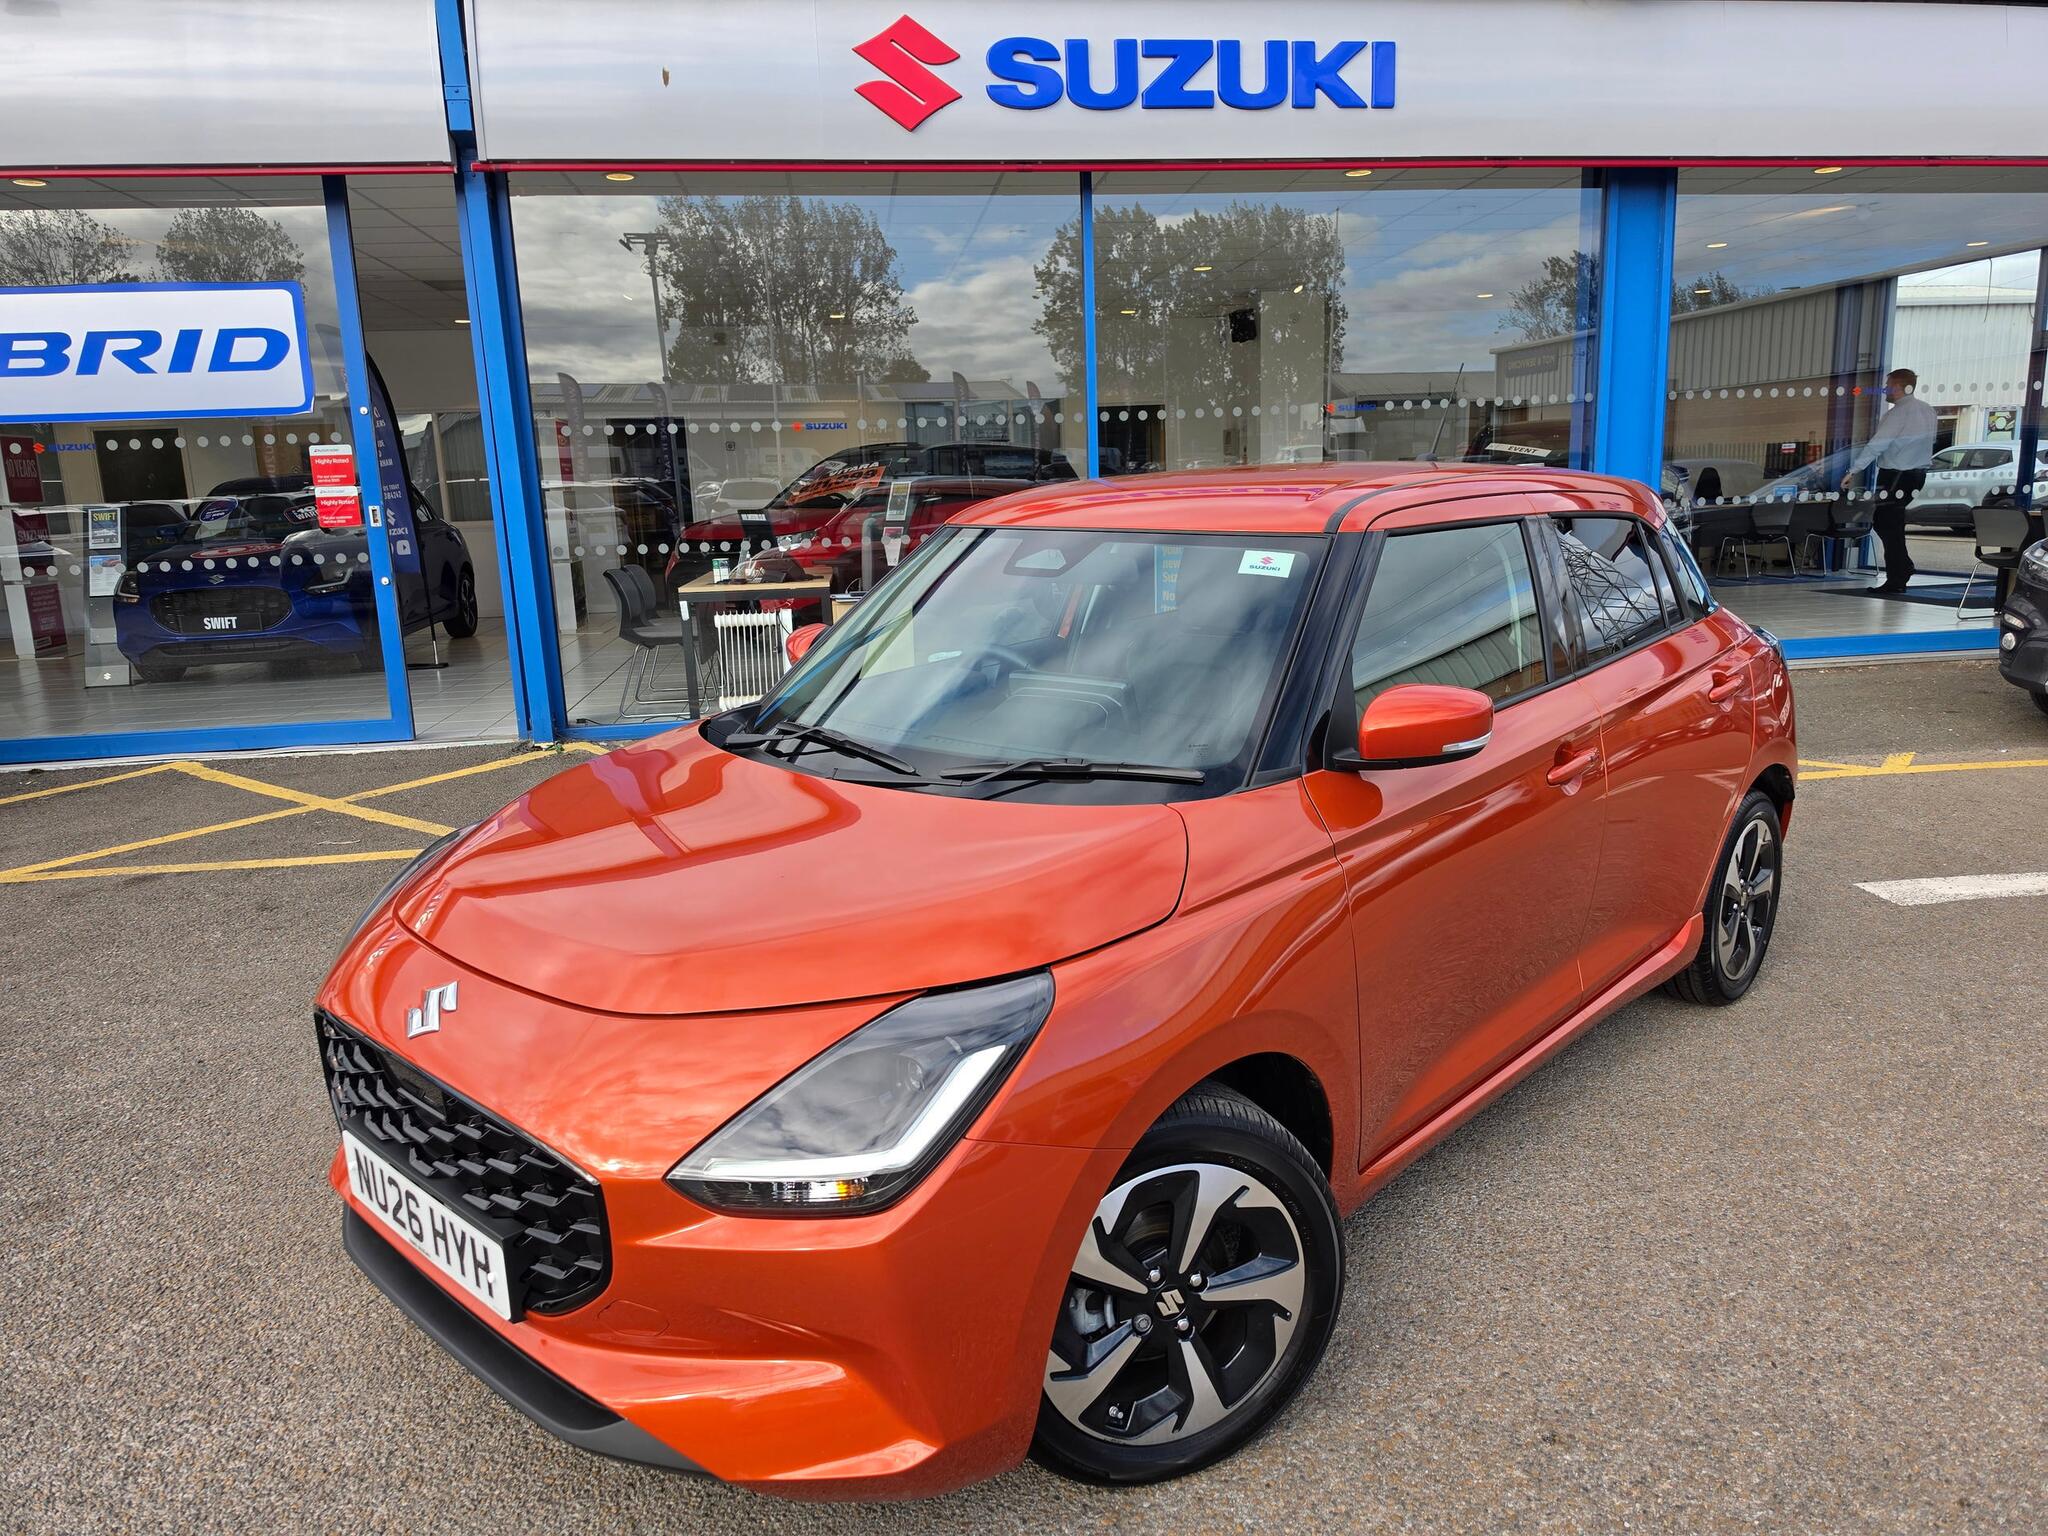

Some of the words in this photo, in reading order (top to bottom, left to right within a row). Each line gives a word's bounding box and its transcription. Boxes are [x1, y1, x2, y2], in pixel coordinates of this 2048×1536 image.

[985, 36, 1397, 110] SUZUKI
[0, 327, 291, 378] BRID
[805, 422, 848, 431] SUZUKI
[1507, 446, 1537, 454] EVENT
[15, 459, 38, 478] YEARS
[829, 461, 879, 476] VITARA
[93, 512, 116, 521] SWIFT
[1249, 564, 1281, 572] SUZUKI
[203, 616, 237, 630] SWIFT
[354, 1147, 424, 1242] NU26
[429, 1206, 495, 1299] HYH
